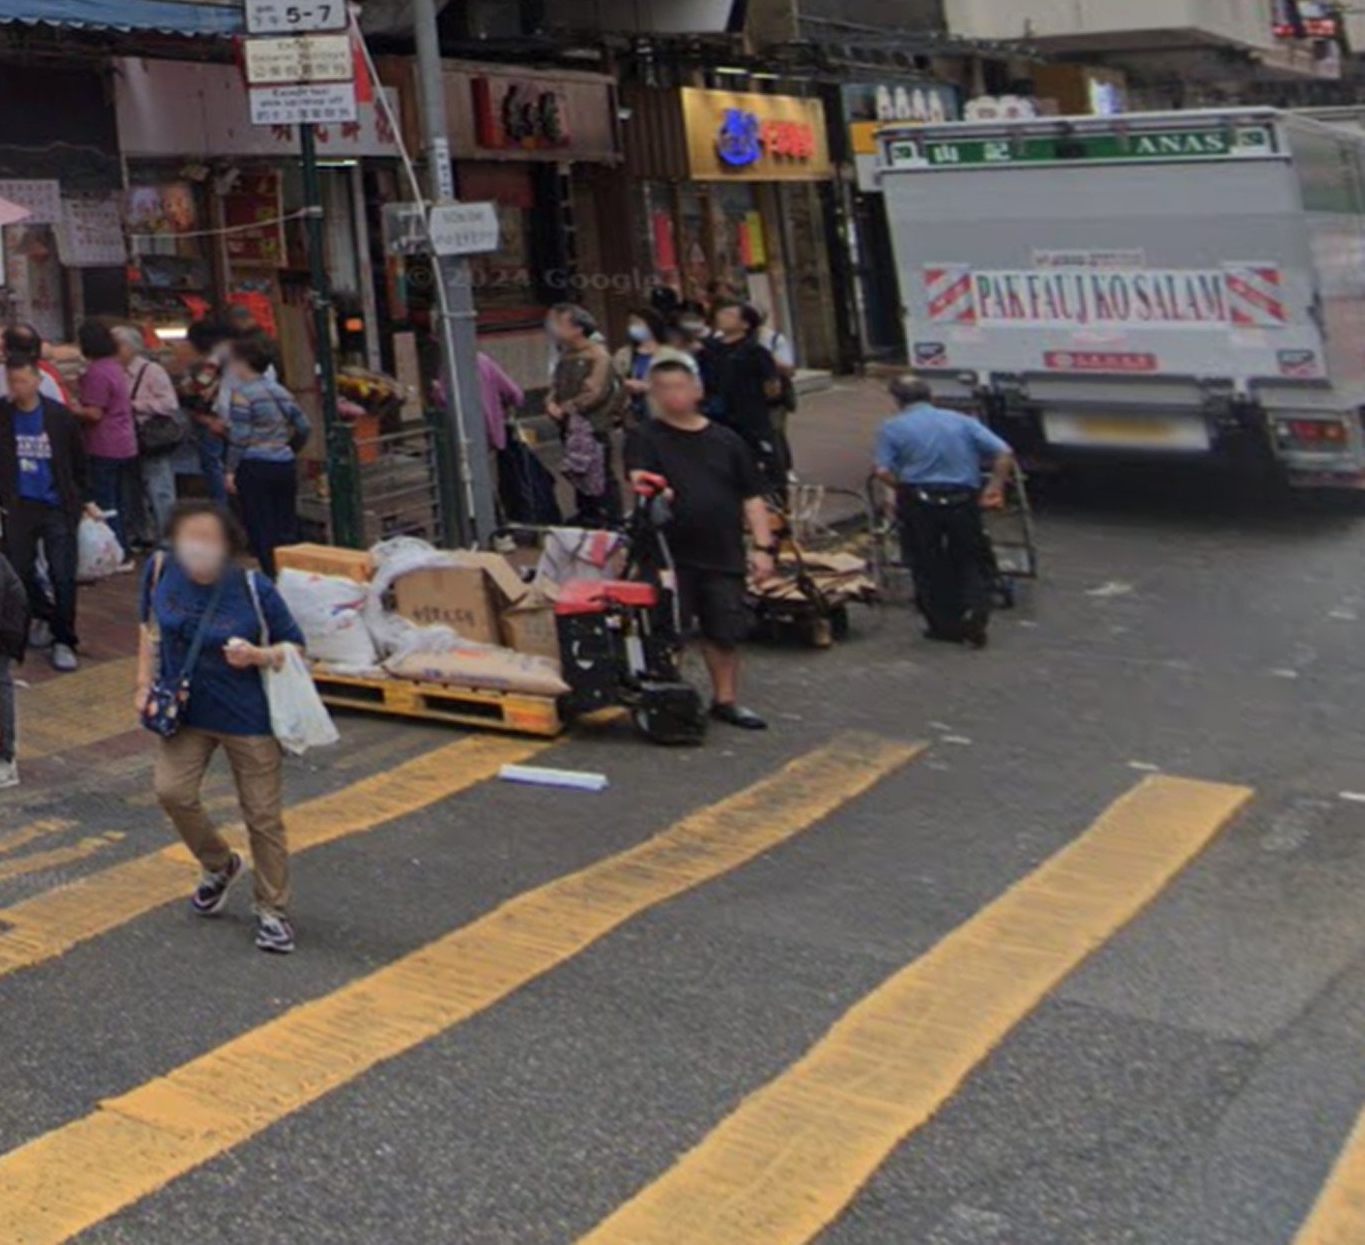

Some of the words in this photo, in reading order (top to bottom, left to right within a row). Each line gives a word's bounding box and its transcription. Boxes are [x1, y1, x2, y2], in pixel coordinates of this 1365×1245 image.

[285, 4, 332, 24] 5-7
[1135, 132, 1226, 155] ANAS
[976, 273, 1025, 320] PAK
[1028, 273, 1088, 324] FAUJ
[1093, 273, 1131, 321] KO
[1133, 273, 1228, 322] SALAM
